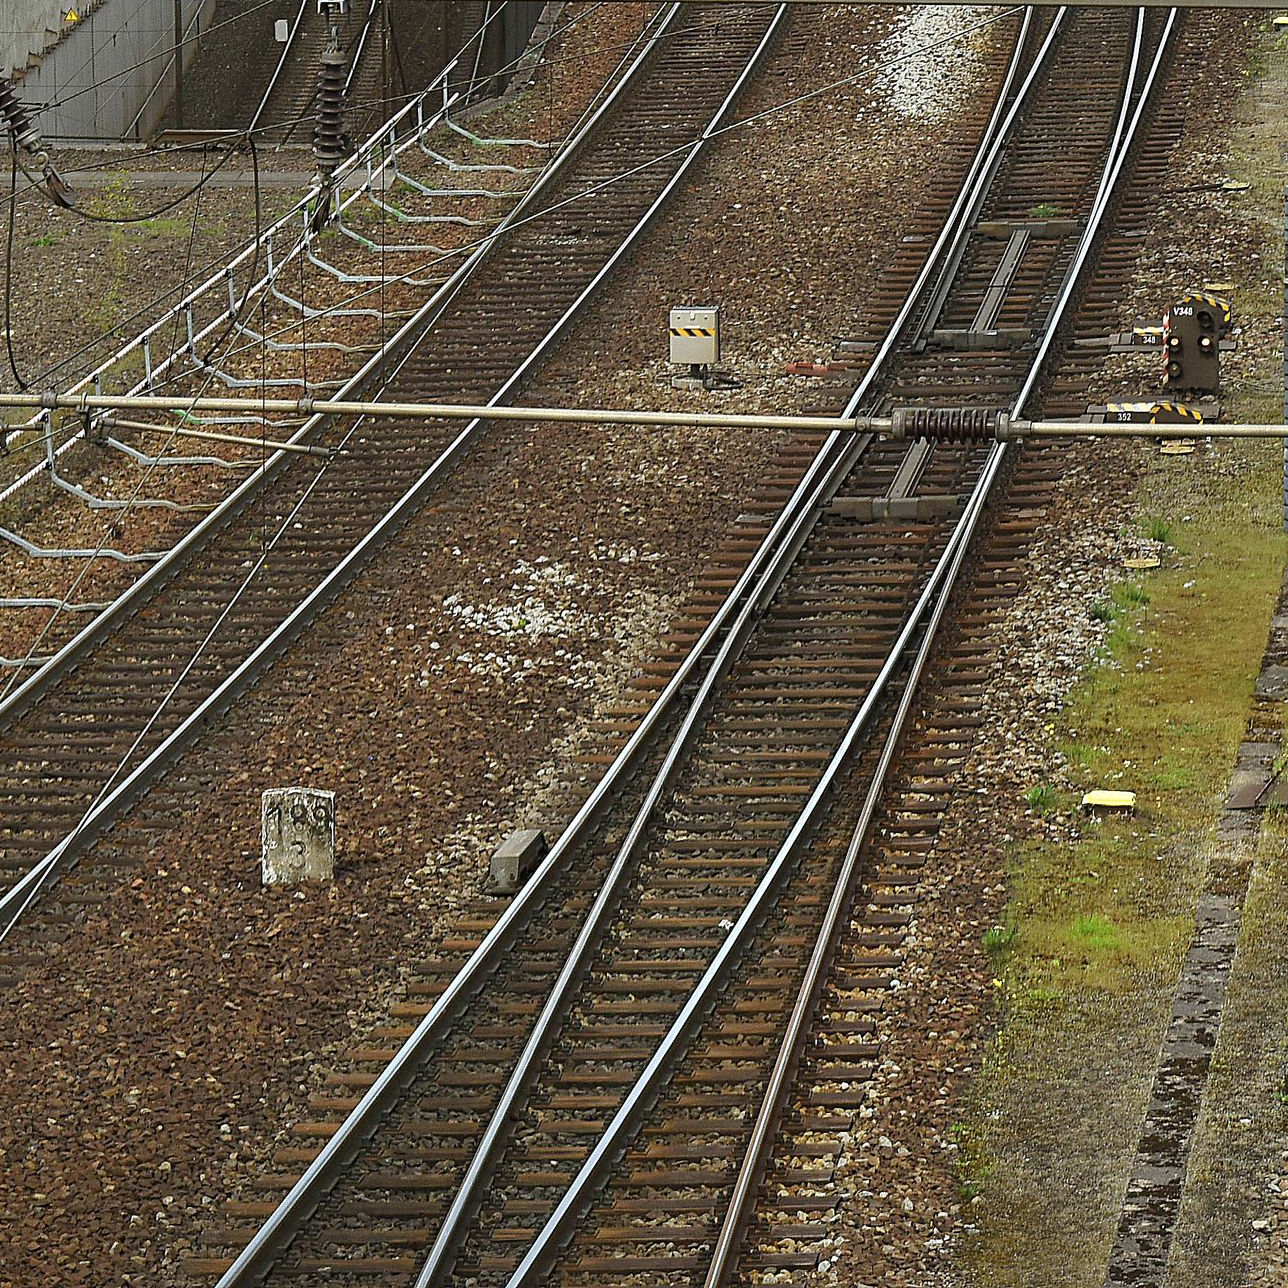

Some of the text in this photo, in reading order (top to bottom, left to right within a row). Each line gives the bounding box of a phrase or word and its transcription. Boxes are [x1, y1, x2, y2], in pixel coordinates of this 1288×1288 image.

[1173, 307, 1193, 316] V348
[1142, 336, 1156, 344] 348
[1117, 412, 1132, 421] 352
[266, 802, 331, 835] 189
